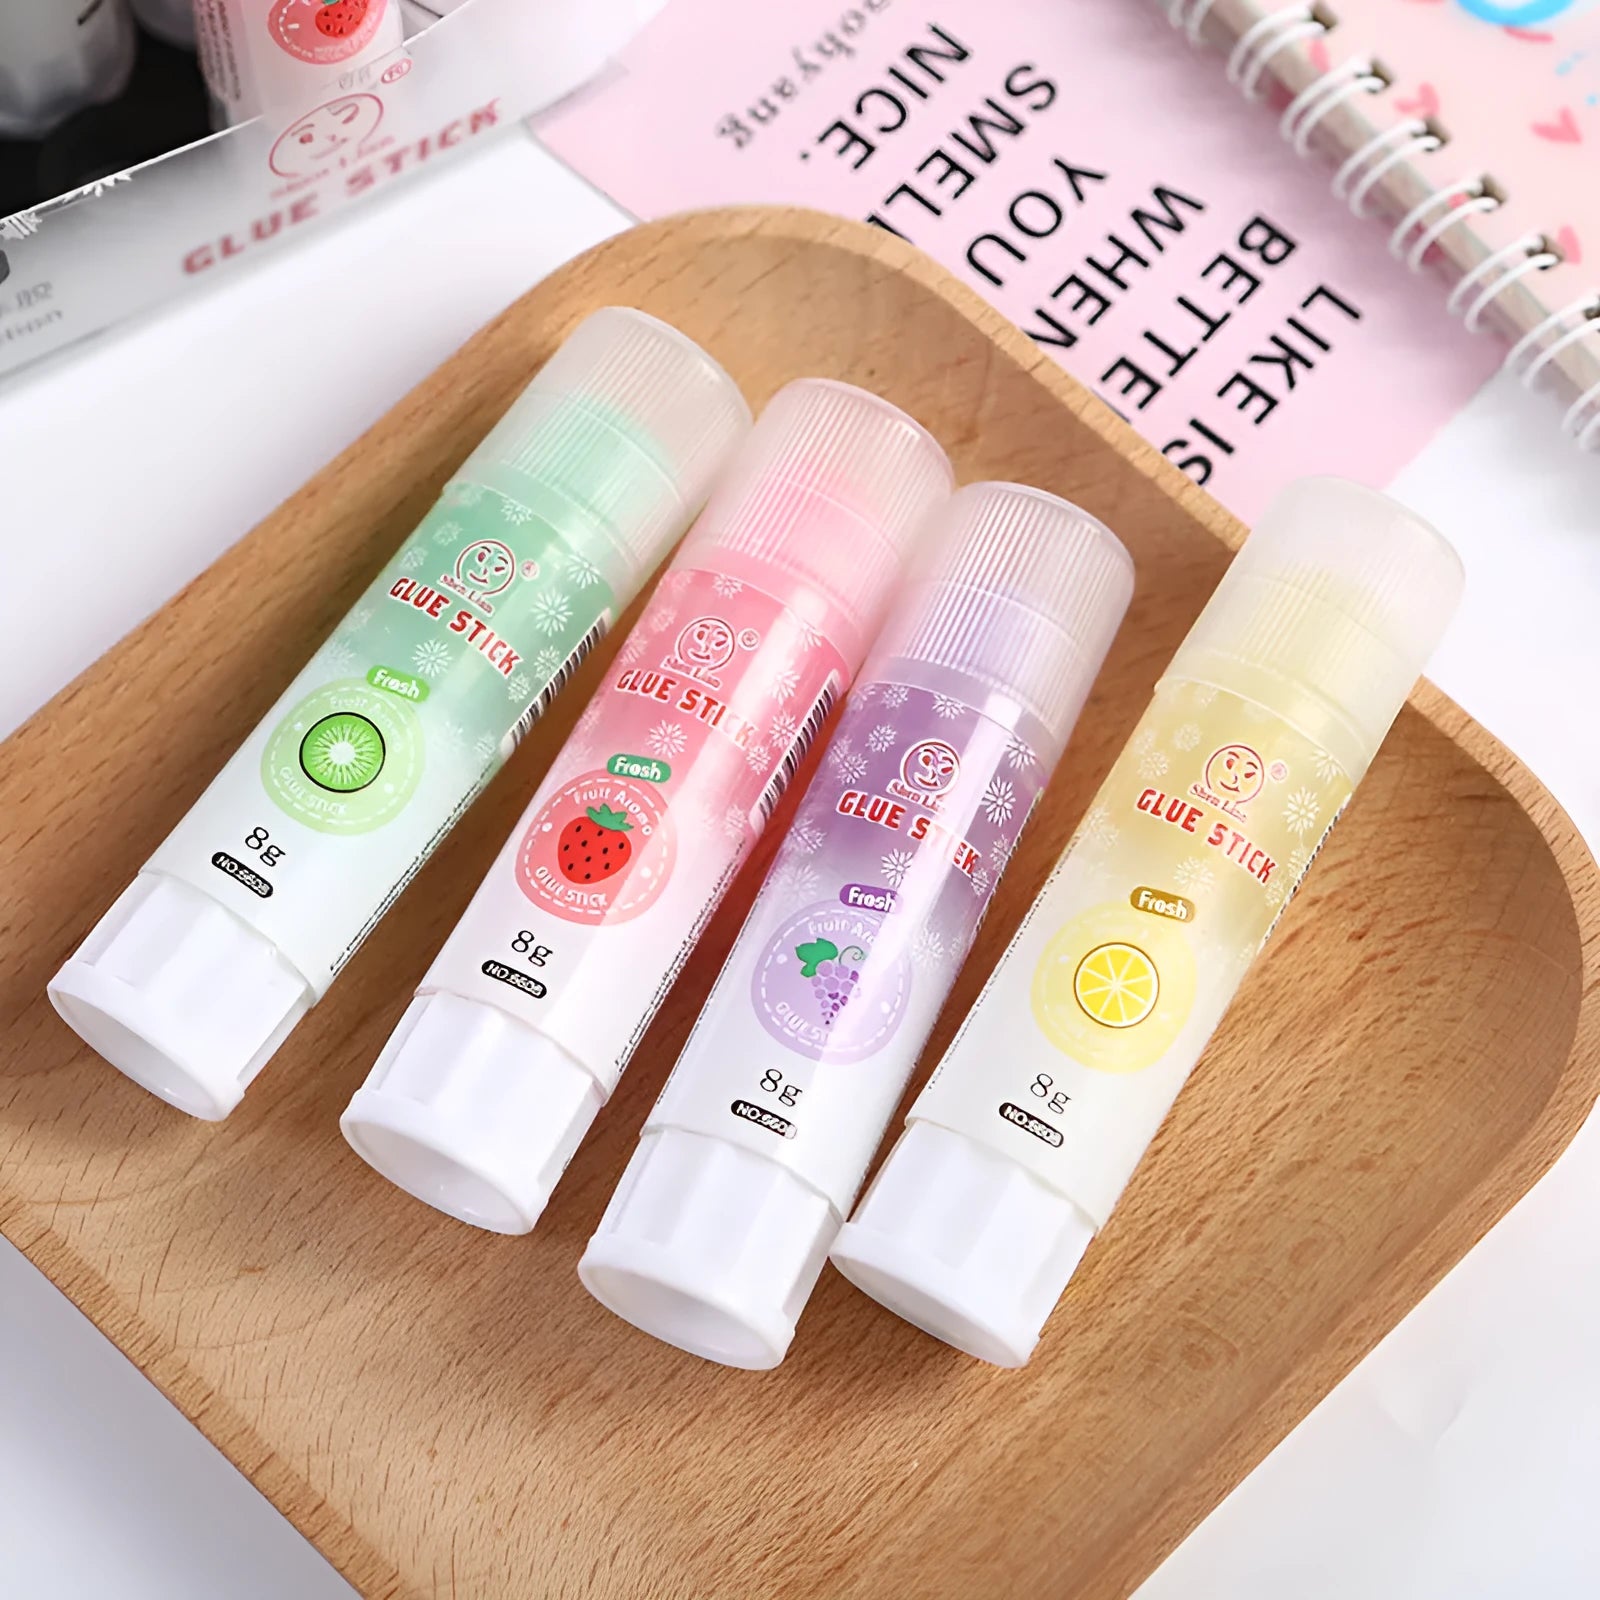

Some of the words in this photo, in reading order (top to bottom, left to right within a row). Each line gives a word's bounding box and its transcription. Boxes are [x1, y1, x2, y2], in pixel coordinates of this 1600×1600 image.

[799, 22, 972, 170] NICE.
[182, 193, 320, 275] GLUE
[345, 99, 502, 195] STICK
[965, 155, 1107, 287] YOU
[1022, 183, 1204, 352] WHEN
[1090, 215, 1298, 423] BETTE
[1216, 285, 1362, 423] LIKE
[1161, 419, 1235, 486] IS
[389, 577, 450, 619] GLUE
[450, 609, 522, 677] STICK
[617, 669, 677, 702] GLUE
[244, 826, 287, 867] 8g
[837, 790, 907, 830] GLUE
[1136, 788, 1204, 834] GLUE
[1207, 822, 1277, 885] STICK
[510, 929, 554, 968] 8g
[759, 1067, 803, 1108] 8g
[1029, 1072, 1072, 1115] 8g
